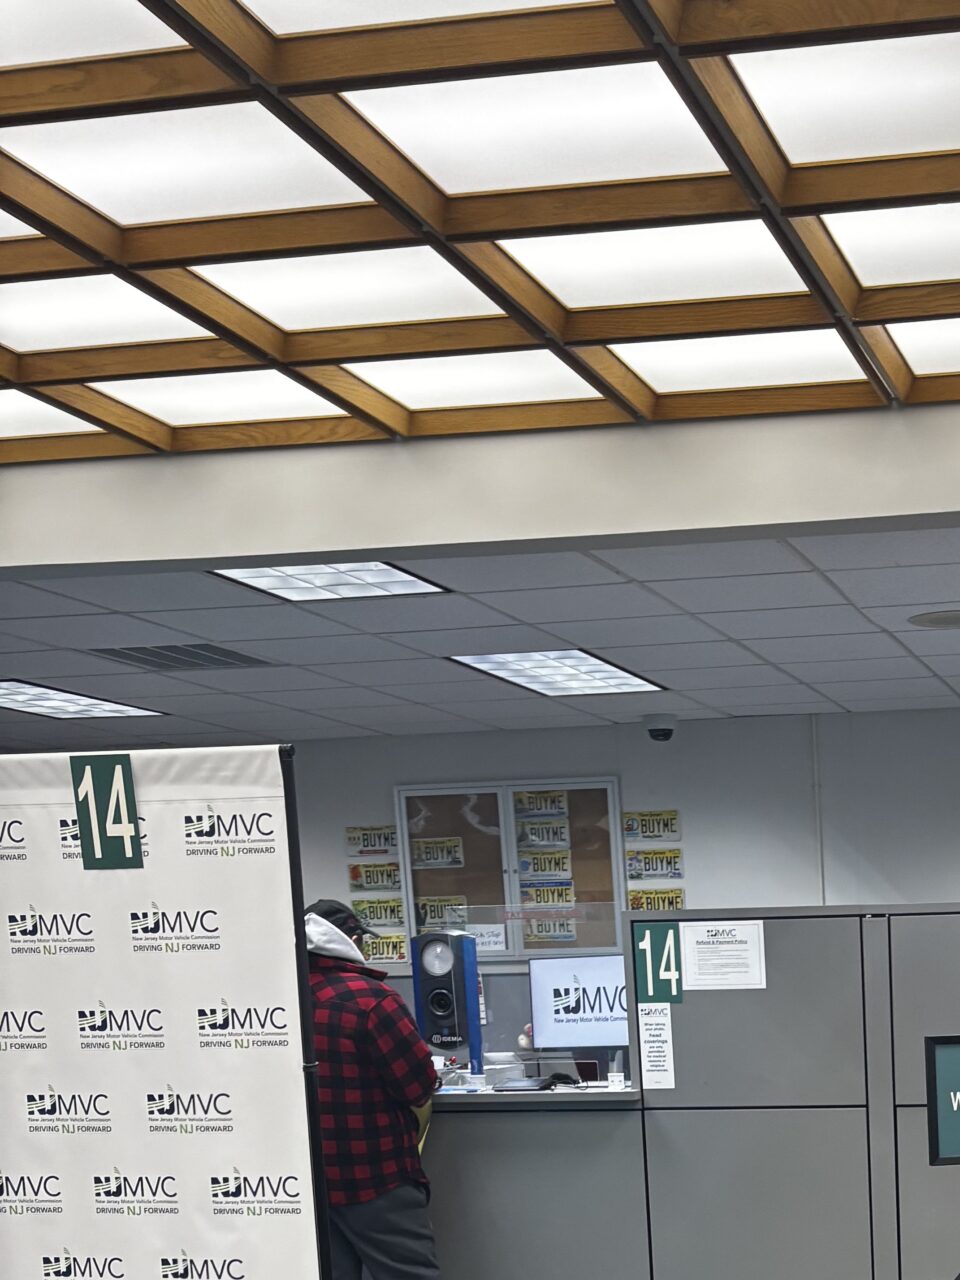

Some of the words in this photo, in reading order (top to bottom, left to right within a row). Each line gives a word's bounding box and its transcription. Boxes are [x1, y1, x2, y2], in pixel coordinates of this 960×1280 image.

[528, 795, 564, 810] BUYME
[78, 764, 135, 858] 14
[185, 813, 274, 837] NJMVC
[641, 818, 677, 833] BUYME
[363, 832, 397, 847] BUYME
[530, 827, 566, 841] BUYME
[220, 846, 236, 857] NJ
[237, 847, 276, 855] FORWARD
[426, 845, 460, 860] BUYME
[533, 857, 568, 872] BUYME
[644, 856, 679, 871] BUYME
[365, 869, 401, 885] BUYME
[536, 889, 571, 903] BUYME
[646, 895, 681, 910] BUYME
[369, 905, 402, 920] BUYME
[8, 913, 93, 936] NJMVC
[131, 910, 219, 934] NJMVC
[43, 945, 57, 955] NJ
[165, 942, 180, 953] NJ
[372, 941, 406, 956] BUYME
[639, 929, 679, 996] 14
[78, 1009, 163, 1032] NJMVC
[197, 1007, 287, 1030] NJMVC
[112, 1040, 128, 1051] NJ
[234, 1039, 250, 1049] NJ
[27, 1094, 109, 1115] NJMVC
[147, 1093, 232, 1115] NJMVC
[61, 1124, 76, 1134] NJ
[179, 1124, 194, 1134] NJ
[0, 1176, 61, 1197] MVC
[94, 1176, 177, 1198] NJMVC
[210, 1176, 300, 1198] NJMVC
[9, 1205, 23, 1215] NJ
[127, 1206, 142, 1216] NJ
[246, 1206, 262, 1216] NJ
[42, 1257, 124, 1278] NJMVC
[161, 1258, 244, 1280] NJMVC
